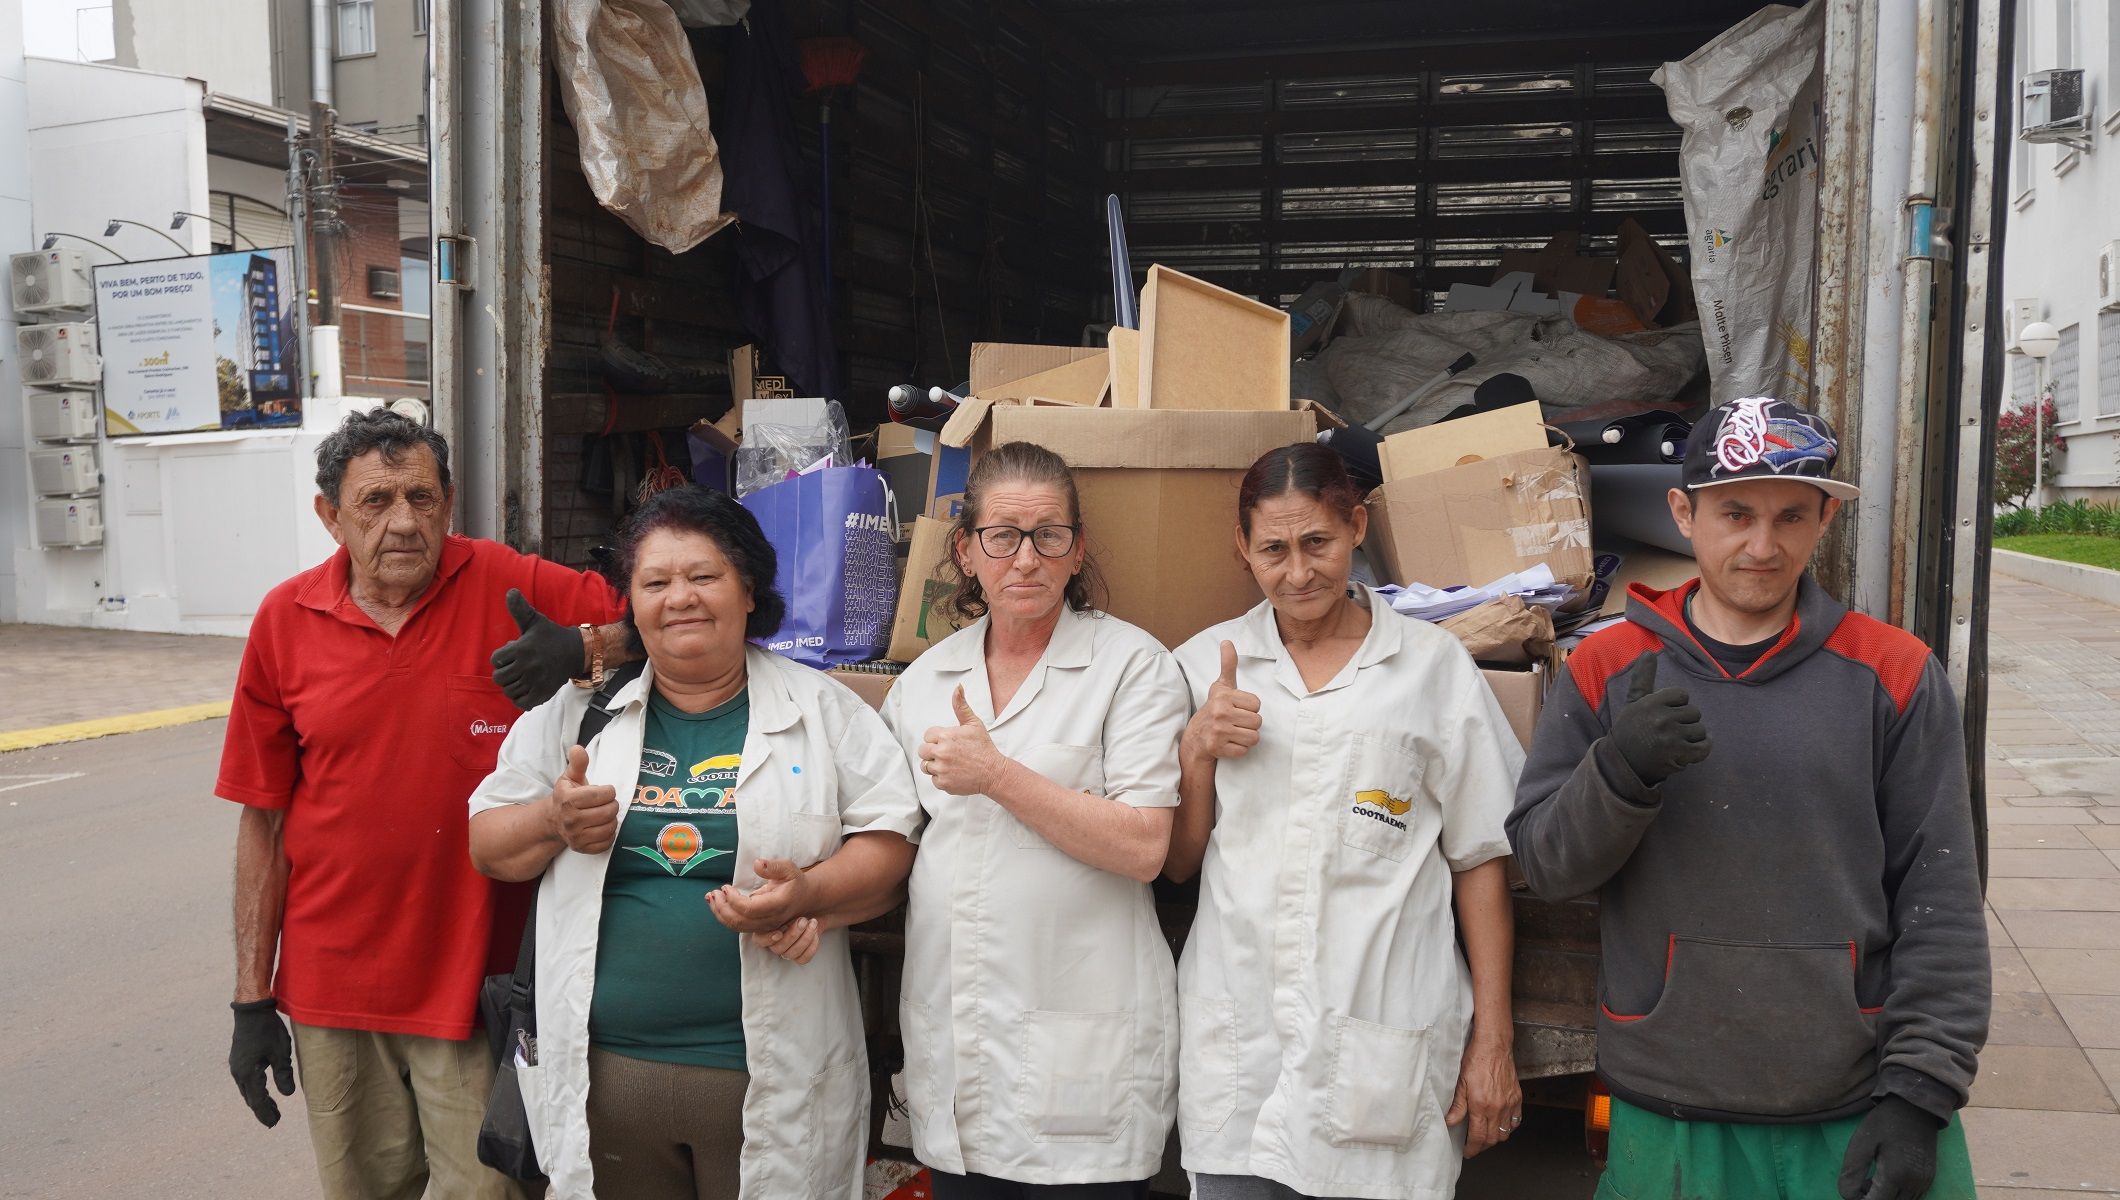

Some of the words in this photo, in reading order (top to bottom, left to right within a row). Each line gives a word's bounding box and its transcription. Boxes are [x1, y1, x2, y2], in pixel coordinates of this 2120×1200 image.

[1763, 137, 1817, 200] agrari
[1705, 229, 1715, 263] agraria
[100, 279, 118, 288] VIVA
[119, 278, 138, 287] BEM,
[140, 275, 165, 285] PERTO
[167, 273, 177, 282] DE
[179, 271, 204, 281] TUDO,
[112, 290, 128, 299] POR
[130, 289, 142, 298] UM
[144, 287, 162, 297] BOM
[164, 284, 192, 295] PREÇO!
[1713, 299, 1726, 333] Malte
[1720, 333, 1733, 364] Pilsen
[845, 512, 896, 532] #IME
[768, 640, 793, 651] IMED
[796, 637, 824, 648] IMED
[473, 722, 507, 734] MASTER
